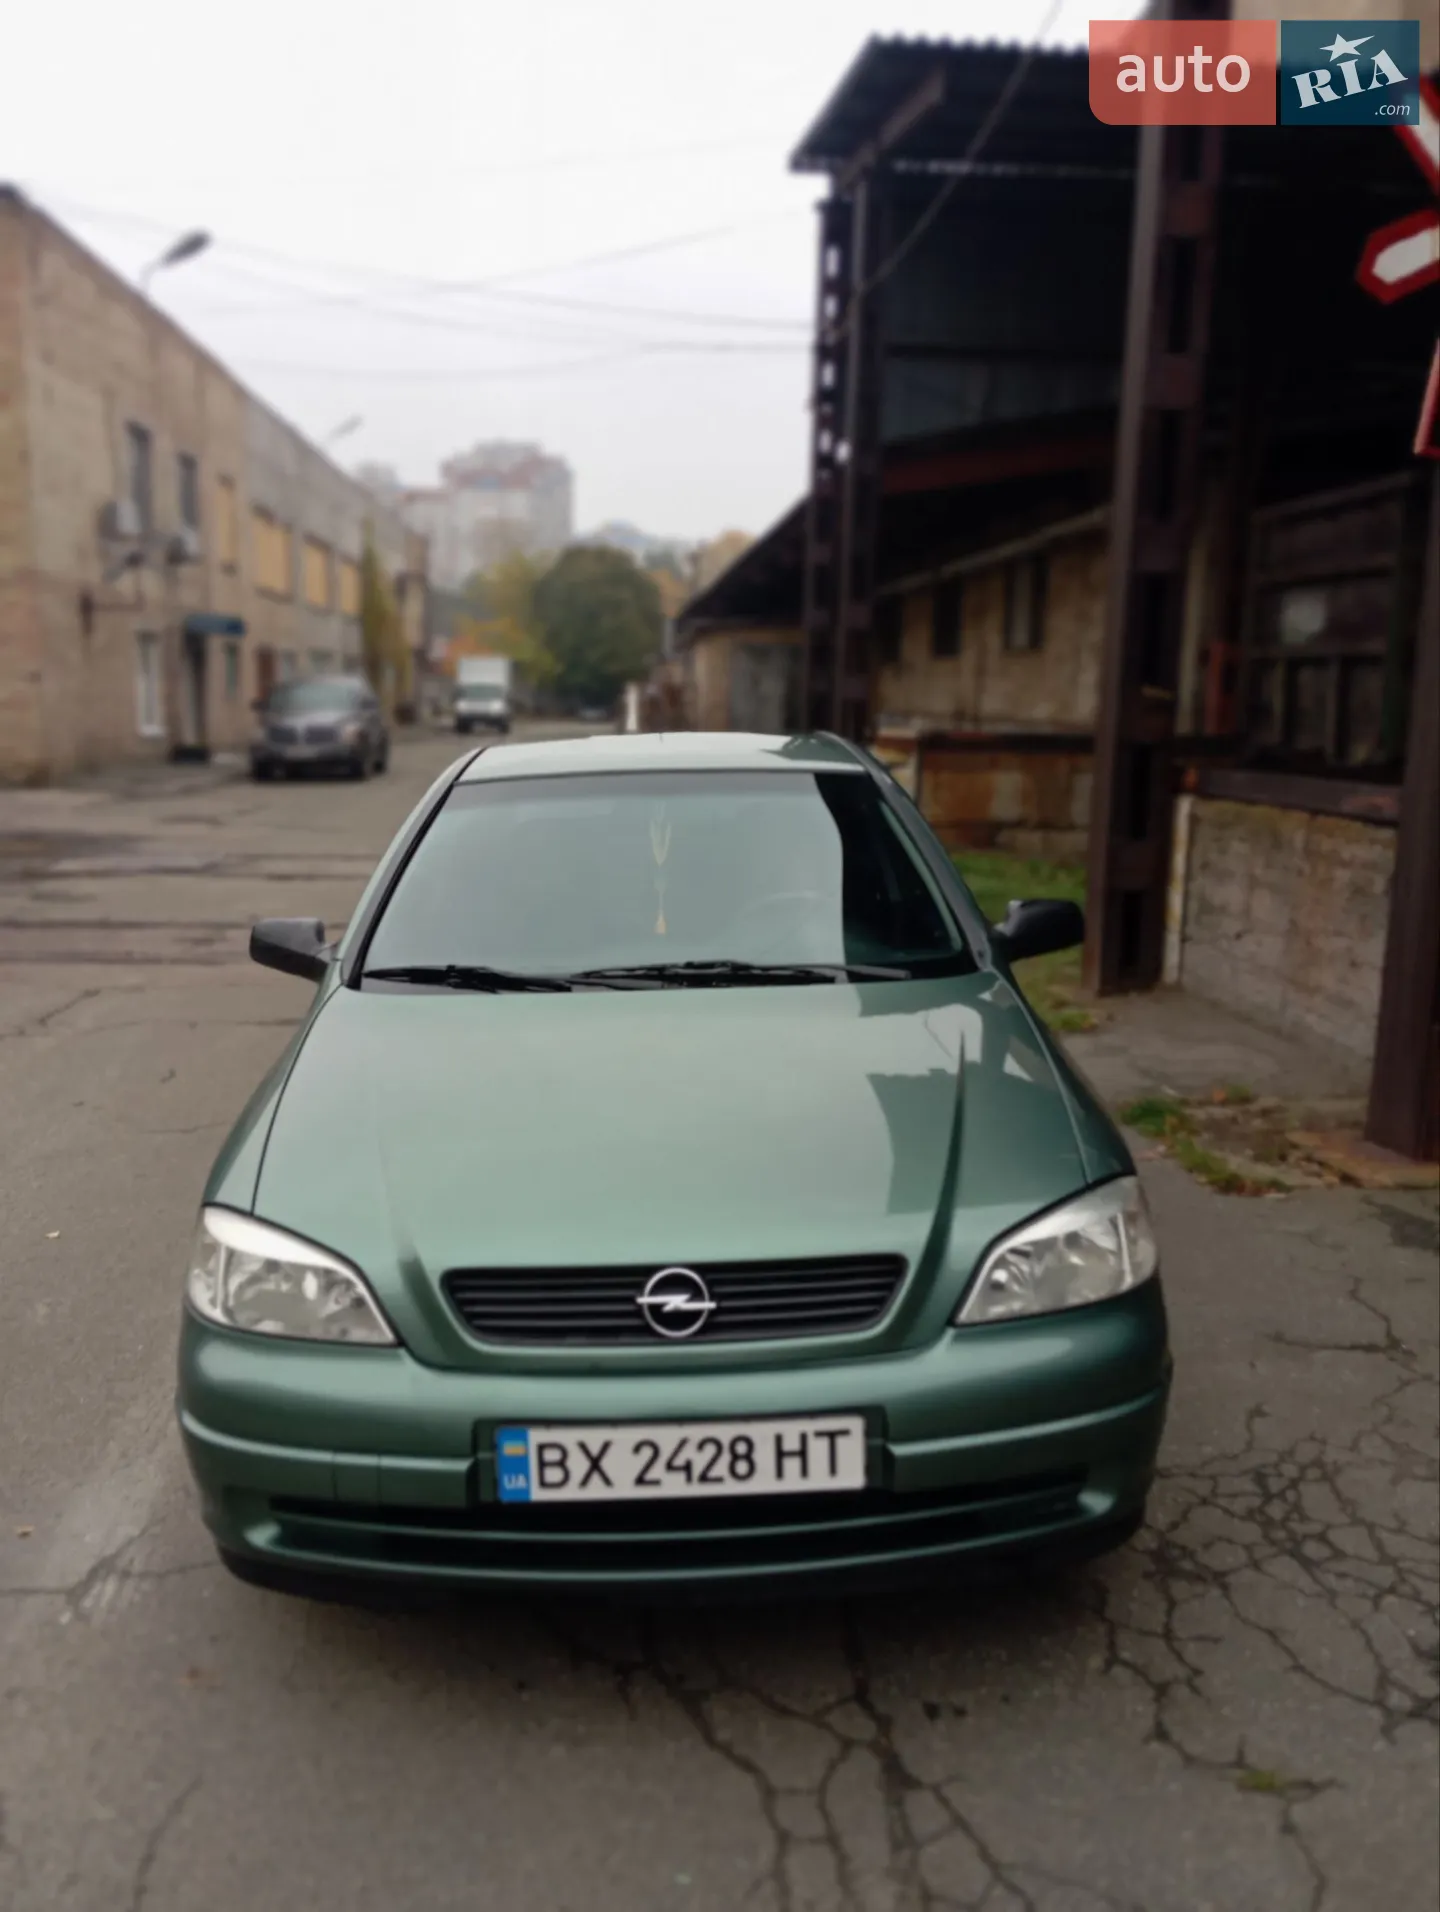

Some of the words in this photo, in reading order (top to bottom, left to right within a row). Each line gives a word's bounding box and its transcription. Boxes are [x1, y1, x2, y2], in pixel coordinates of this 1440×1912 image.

[537, 1440, 613, 1490] BX
[632, 1434, 756, 1486] 2428
[774, 1428, 851, 1480] HT
[504, 1474, 528, 1489] UA
